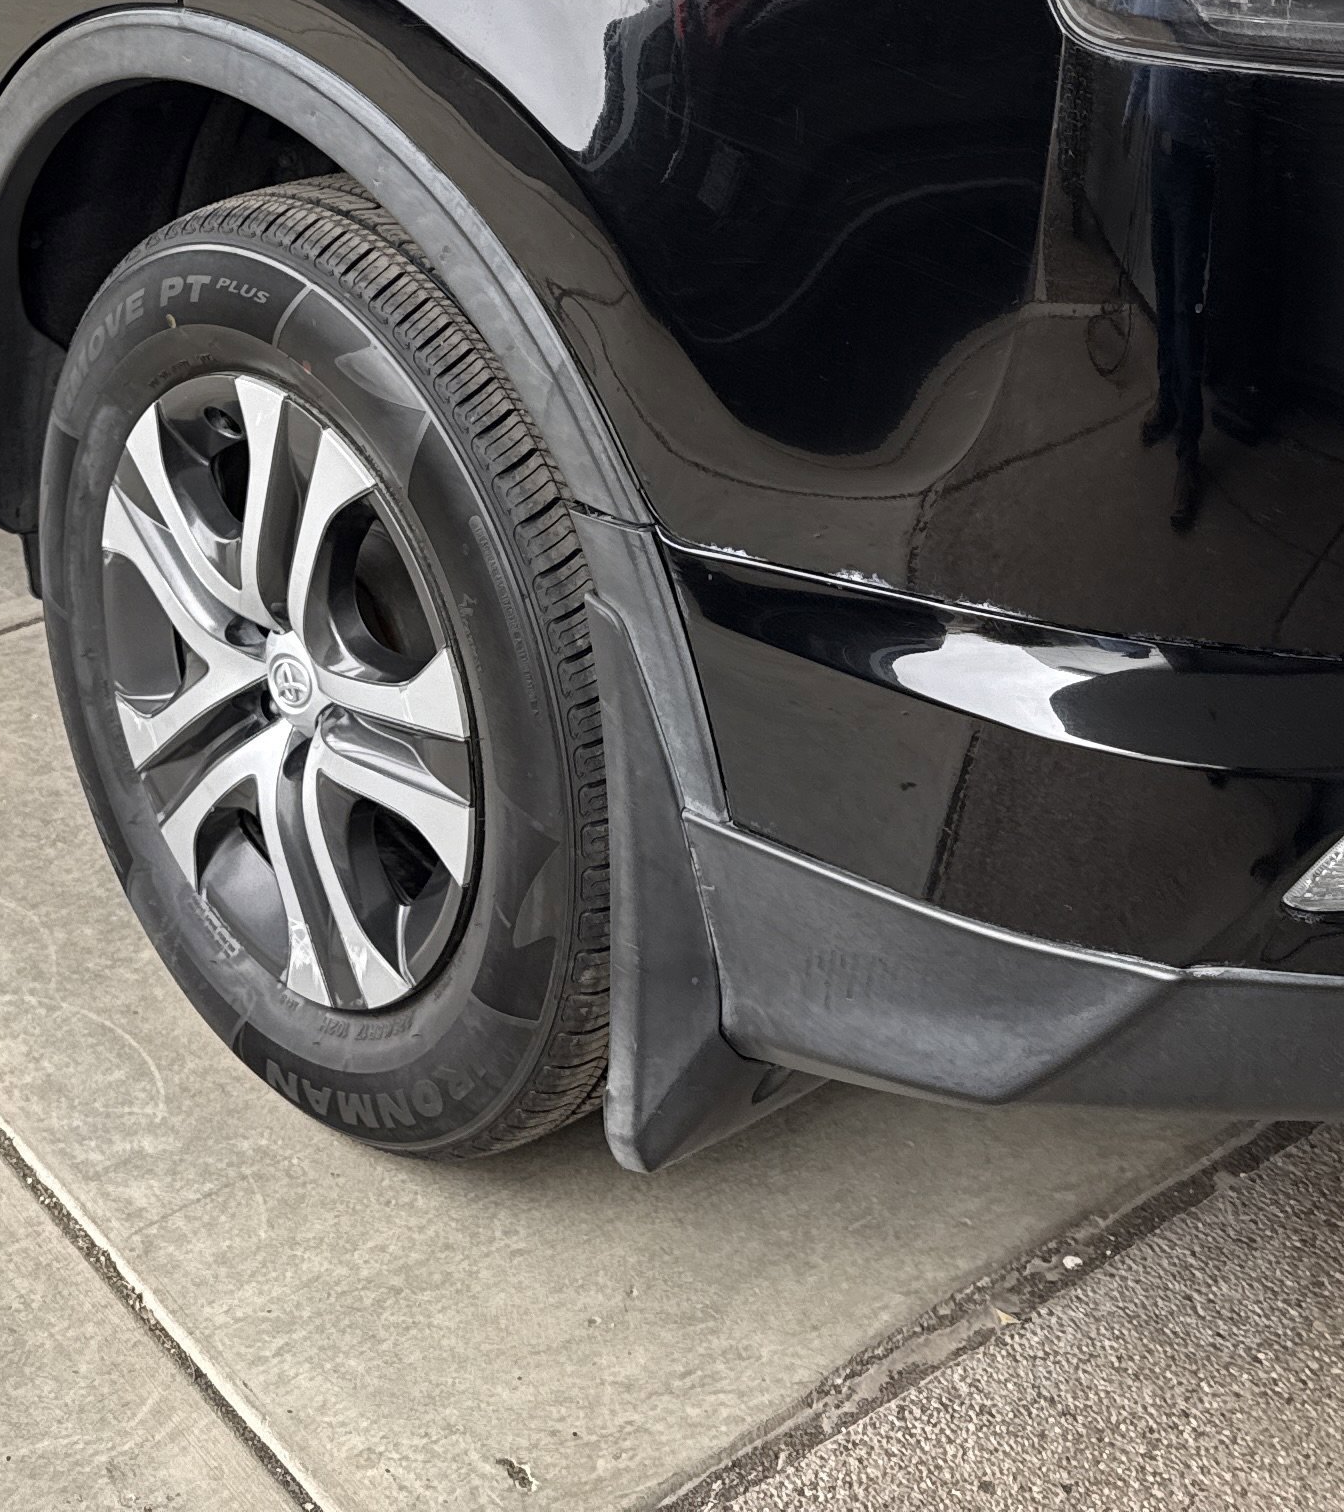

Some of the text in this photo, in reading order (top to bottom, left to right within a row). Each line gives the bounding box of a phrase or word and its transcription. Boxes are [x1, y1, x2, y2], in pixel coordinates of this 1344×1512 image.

[160, 274, 212, 307] PT
[216, 276, 271, 304] PLUS
[265, 1057, 487, 1129] IRONMAN
